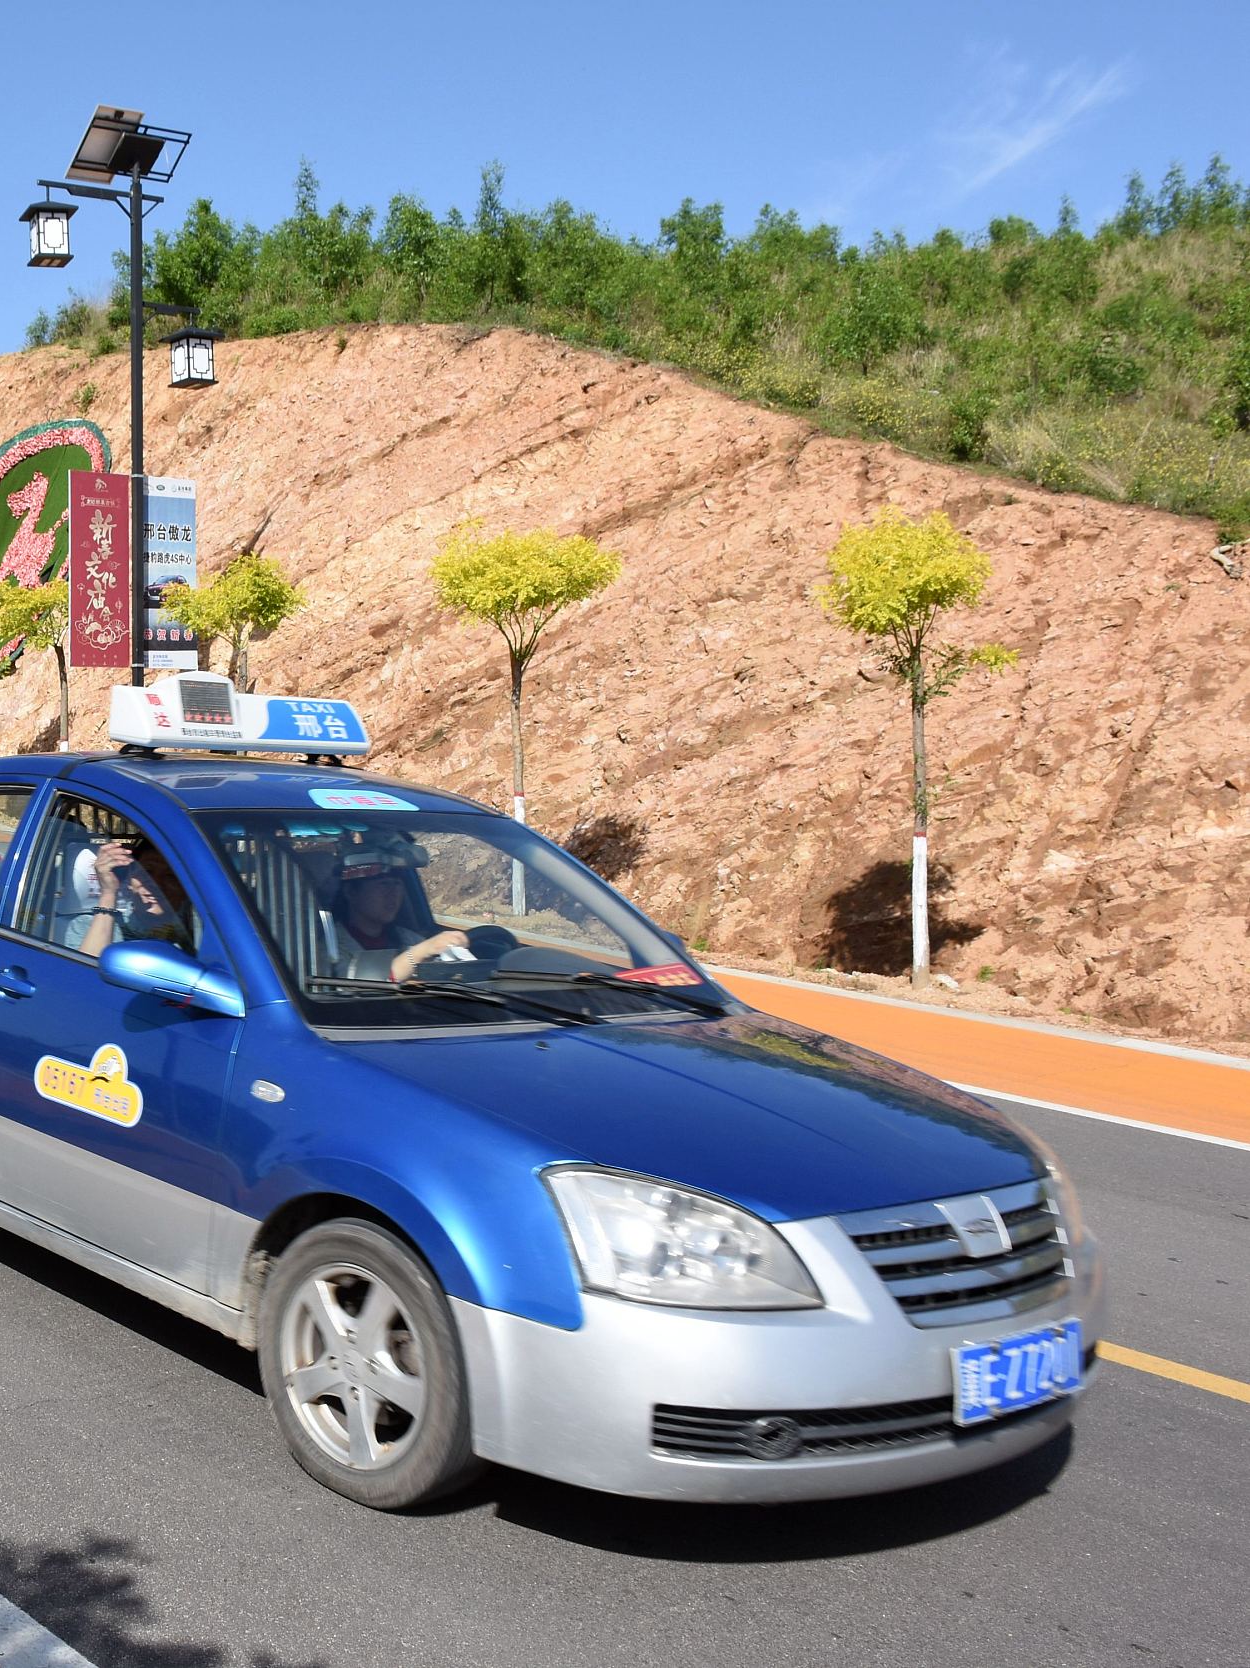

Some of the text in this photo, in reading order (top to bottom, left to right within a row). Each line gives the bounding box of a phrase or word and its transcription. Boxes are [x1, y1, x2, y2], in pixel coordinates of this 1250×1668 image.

[144, 523, 192, 542] 邢台傲龙
[144, 629, 194, 641] 恭贺新春
[285, 701, 335, 714] TAXI
[292, 714, 349, 739] 邢台
